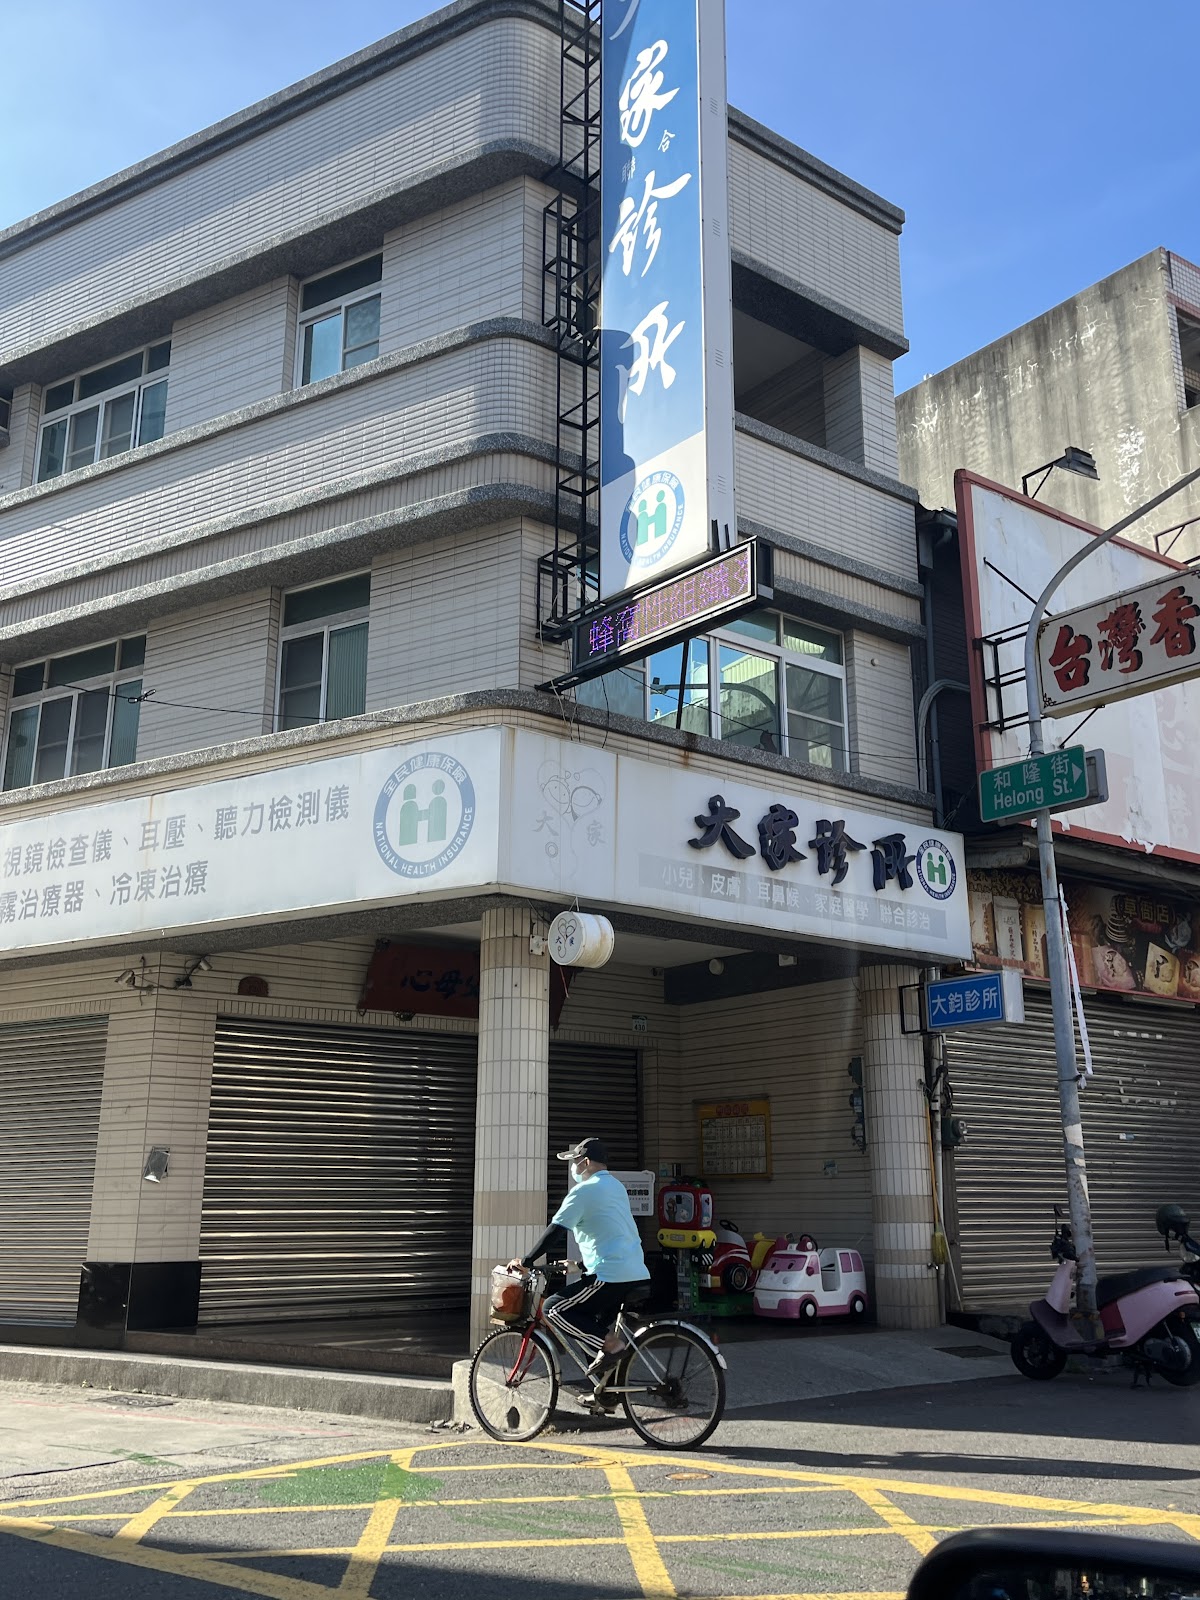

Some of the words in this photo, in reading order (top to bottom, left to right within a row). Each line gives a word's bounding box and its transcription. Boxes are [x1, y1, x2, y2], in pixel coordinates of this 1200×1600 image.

[1048, 585, 1200, 692] 台灣香
[383, 753, 467, 797] 全民健康保險
[993, 753, 1070, 792] 和隆街
[994, 787, 1044, 811] Helong
[1053, 778, 1073, 796] St.
[375, 822, 398, 869] NATIONAL
[400, 861, 437, 875] HEALTH
[439, 806, 473, 867] INSURANCE
[688, 794, 916, 891] 大家診所
[931, 986, 998, 1016] 大鈞診所
[634, 1023, 646, 1032] 430
